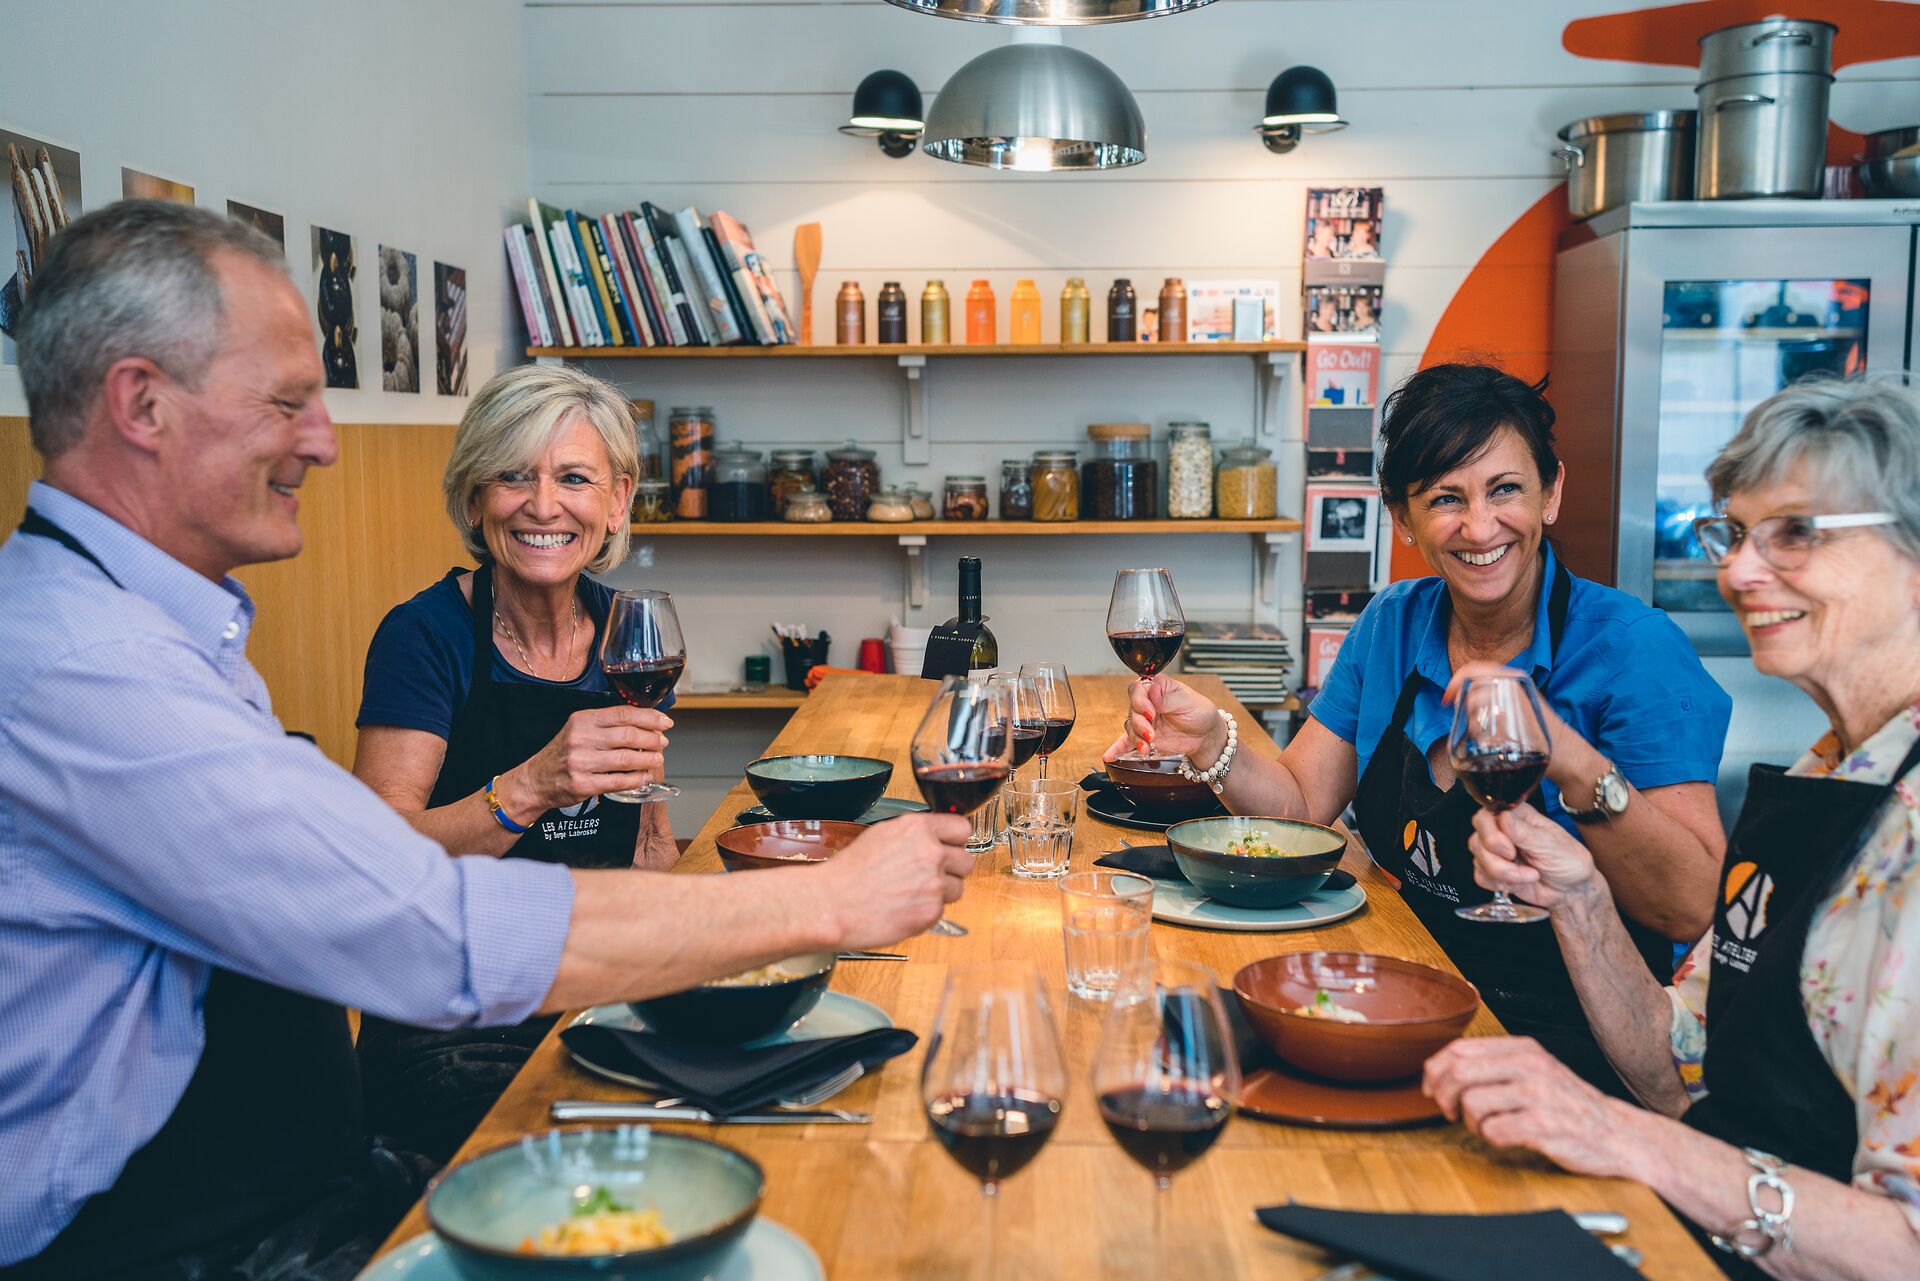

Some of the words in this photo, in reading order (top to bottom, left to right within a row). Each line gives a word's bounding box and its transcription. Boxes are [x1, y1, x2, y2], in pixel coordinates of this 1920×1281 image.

[1316, 349, 1338, 369] Go
[1339, 349, 1372, 369] Out!
[542, 822, 556, 832] LES
[558, 818, 600, 831] ATELIERS
[544, 832, 552, 840] by
[569, 828, 598, 837] Labrosse
